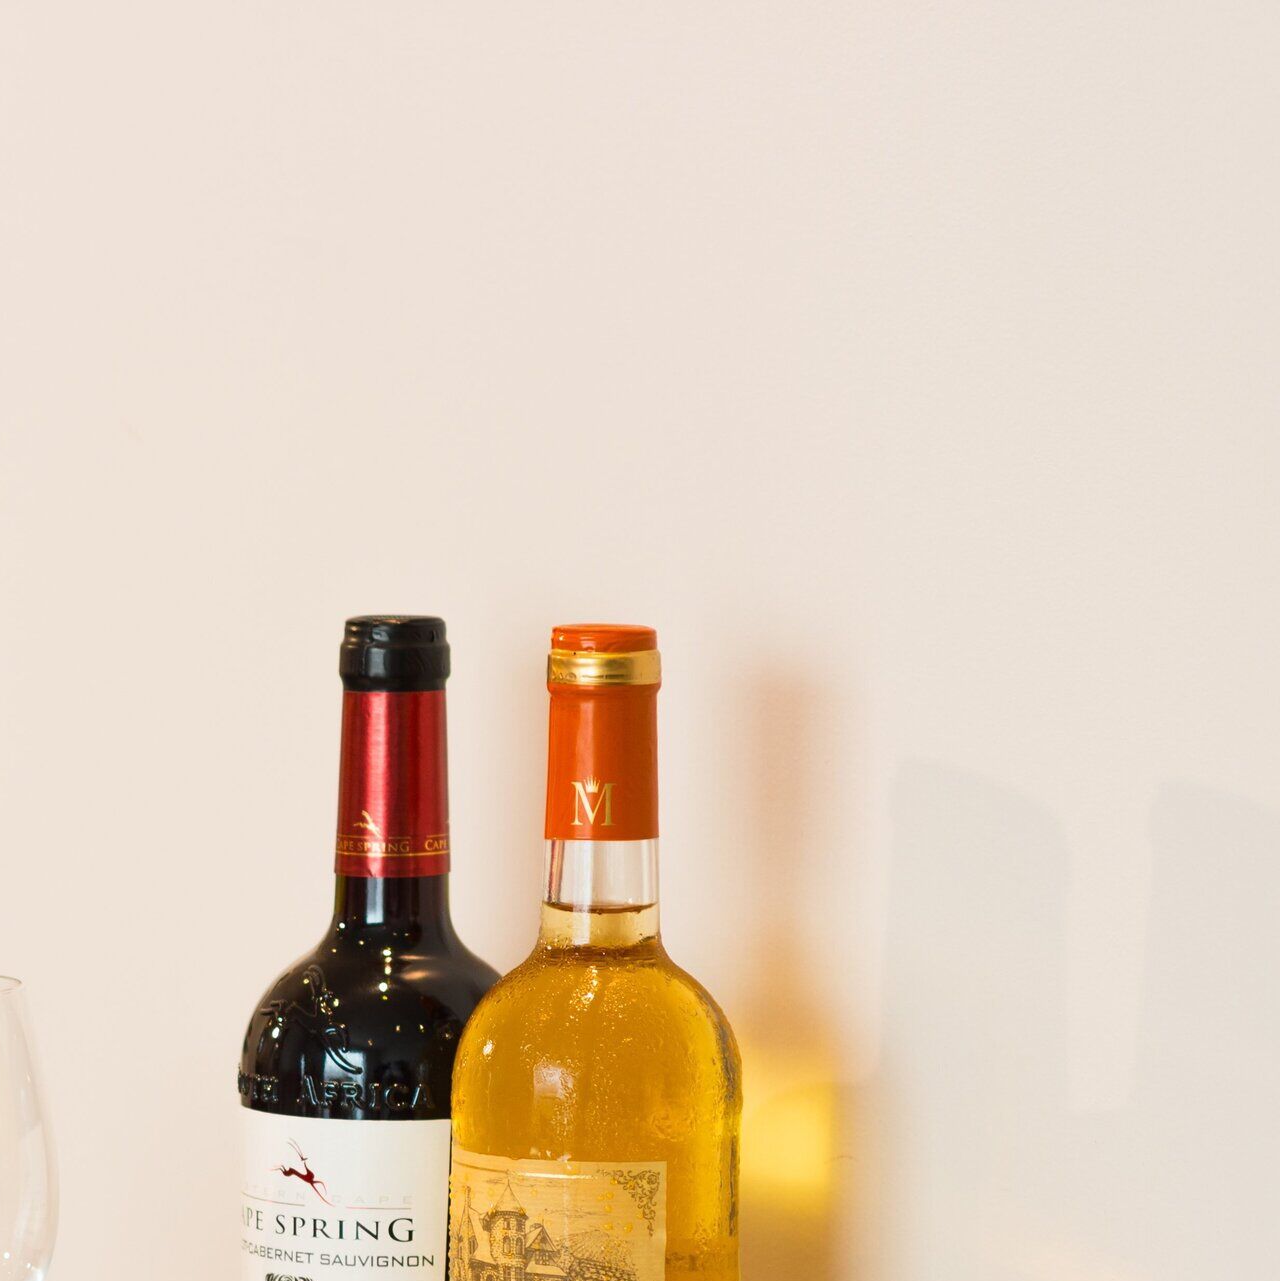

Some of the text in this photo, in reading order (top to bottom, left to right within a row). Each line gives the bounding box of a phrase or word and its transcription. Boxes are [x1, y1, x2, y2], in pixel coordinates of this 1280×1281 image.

[571, 781, 617, 826] M
[296, 1074, 436, 1112] AFRICA
[275, 1214, 416, 1243] SPRING
[320, 1253, 435, 1268] SAUVIGNON
